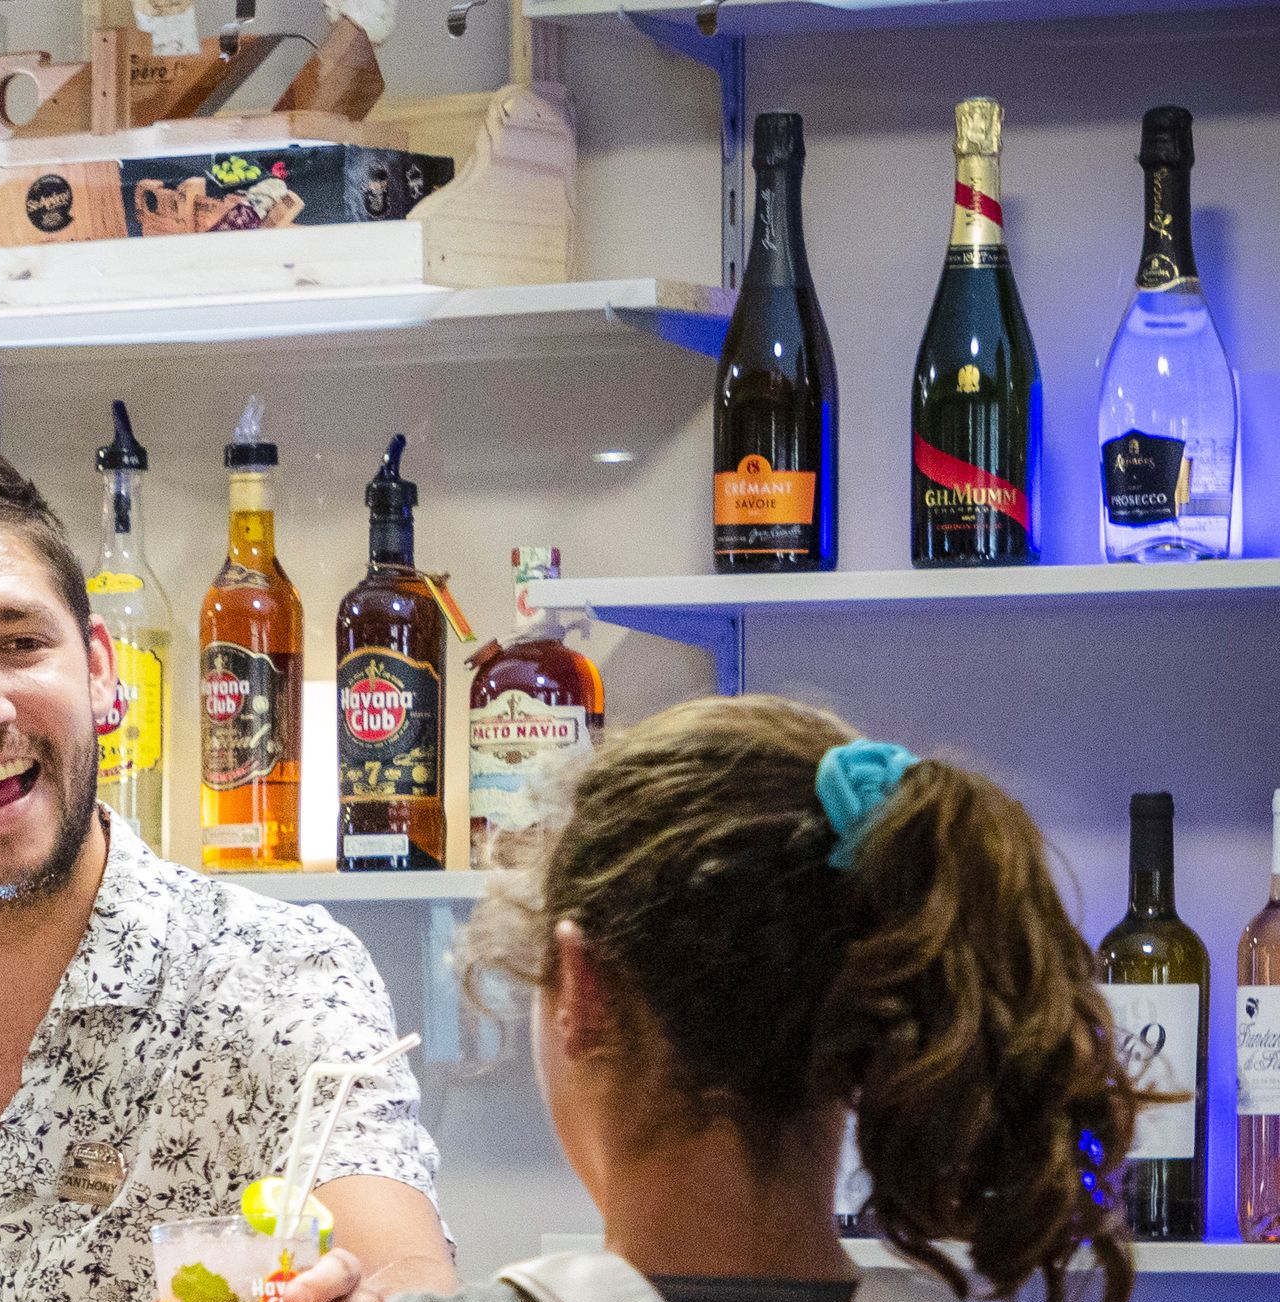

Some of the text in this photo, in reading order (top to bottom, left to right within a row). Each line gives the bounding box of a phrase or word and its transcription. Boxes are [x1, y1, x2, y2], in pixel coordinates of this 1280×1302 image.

[724, 479, 794, 496] CRÉMANT
[735, 499, 777, 510] SAVOIE
[1111, 492, 1168, 507] PROSECCO
[206, 695, 237, 714] Club
[341, 687, 414, 710] Havana
[350, 710, 397, 732] Club
[516, 724, 569, 738] NAVIO
[64, 1176, 118, 1193] ANTHONY
[252, 1277, 287, 1296] Hav
